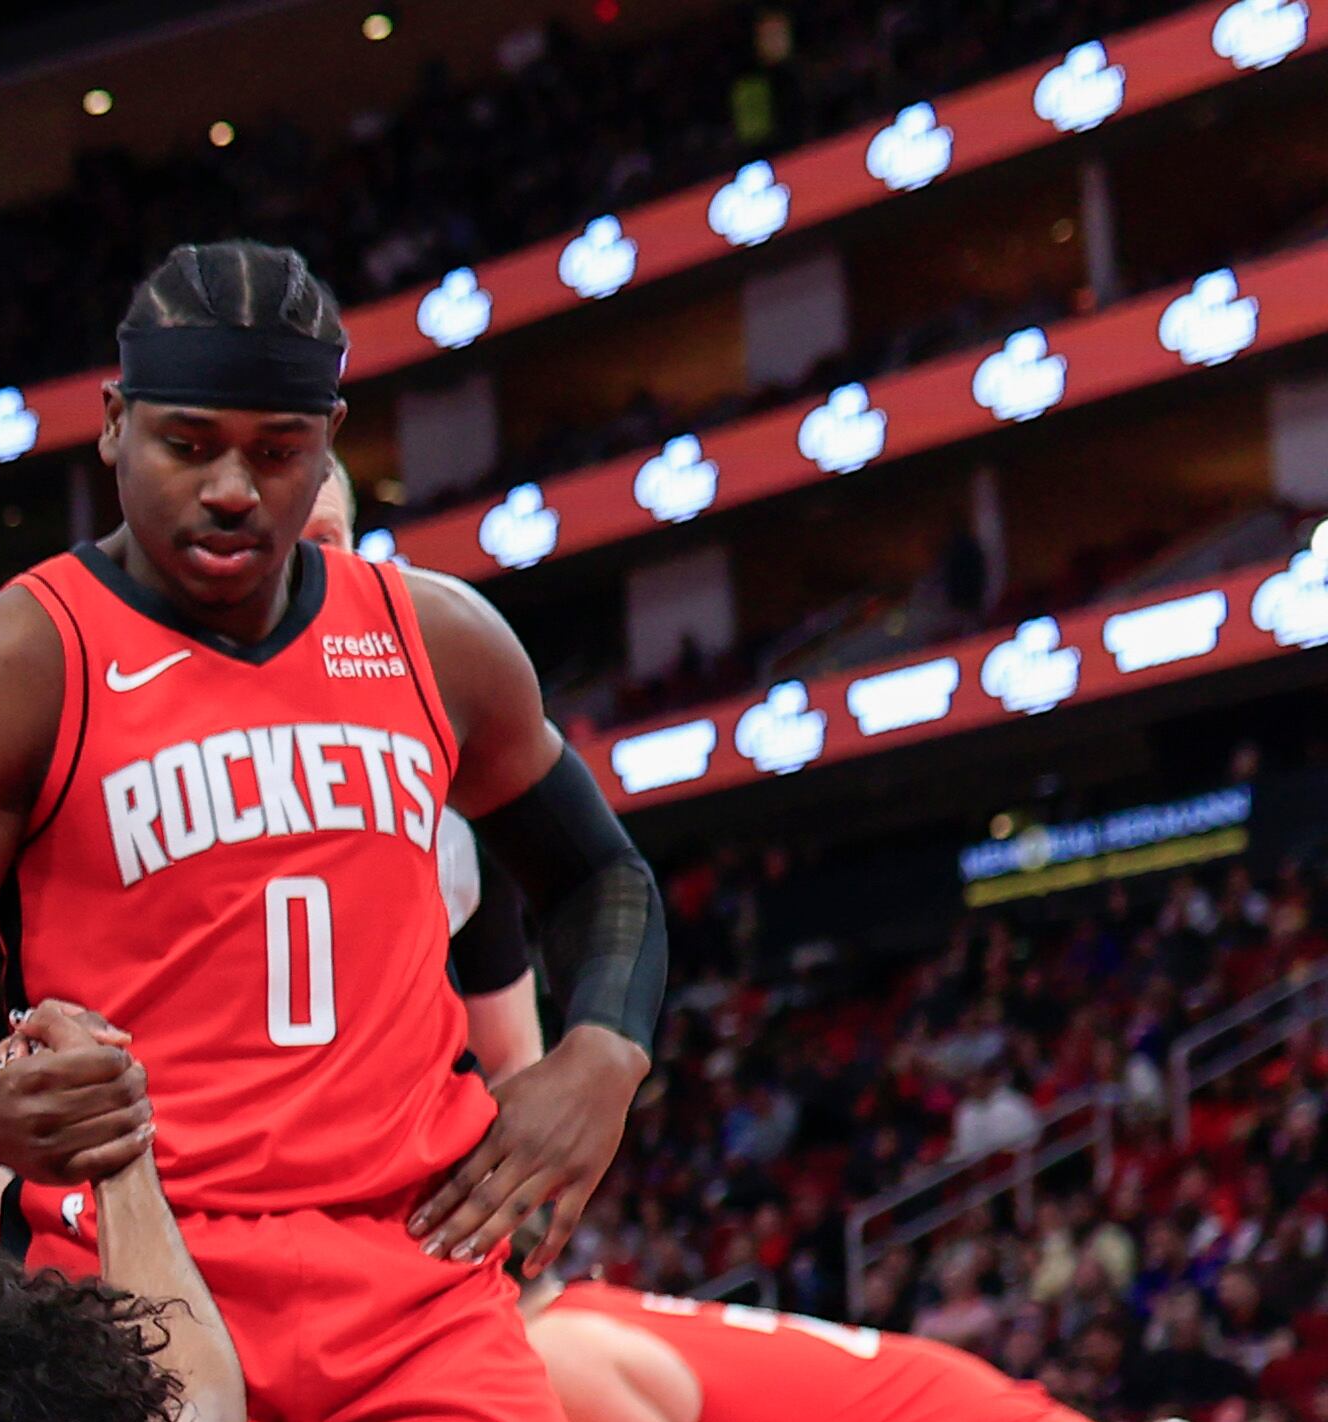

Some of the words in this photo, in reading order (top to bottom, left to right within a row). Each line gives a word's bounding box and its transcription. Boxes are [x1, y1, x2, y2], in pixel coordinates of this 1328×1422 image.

[323, 631, 397, 657] credit
[323, 652, 406, 678] karma
[101, 722, 436, 888] ROCKETS
[265, 874, 337, 1047] 0
